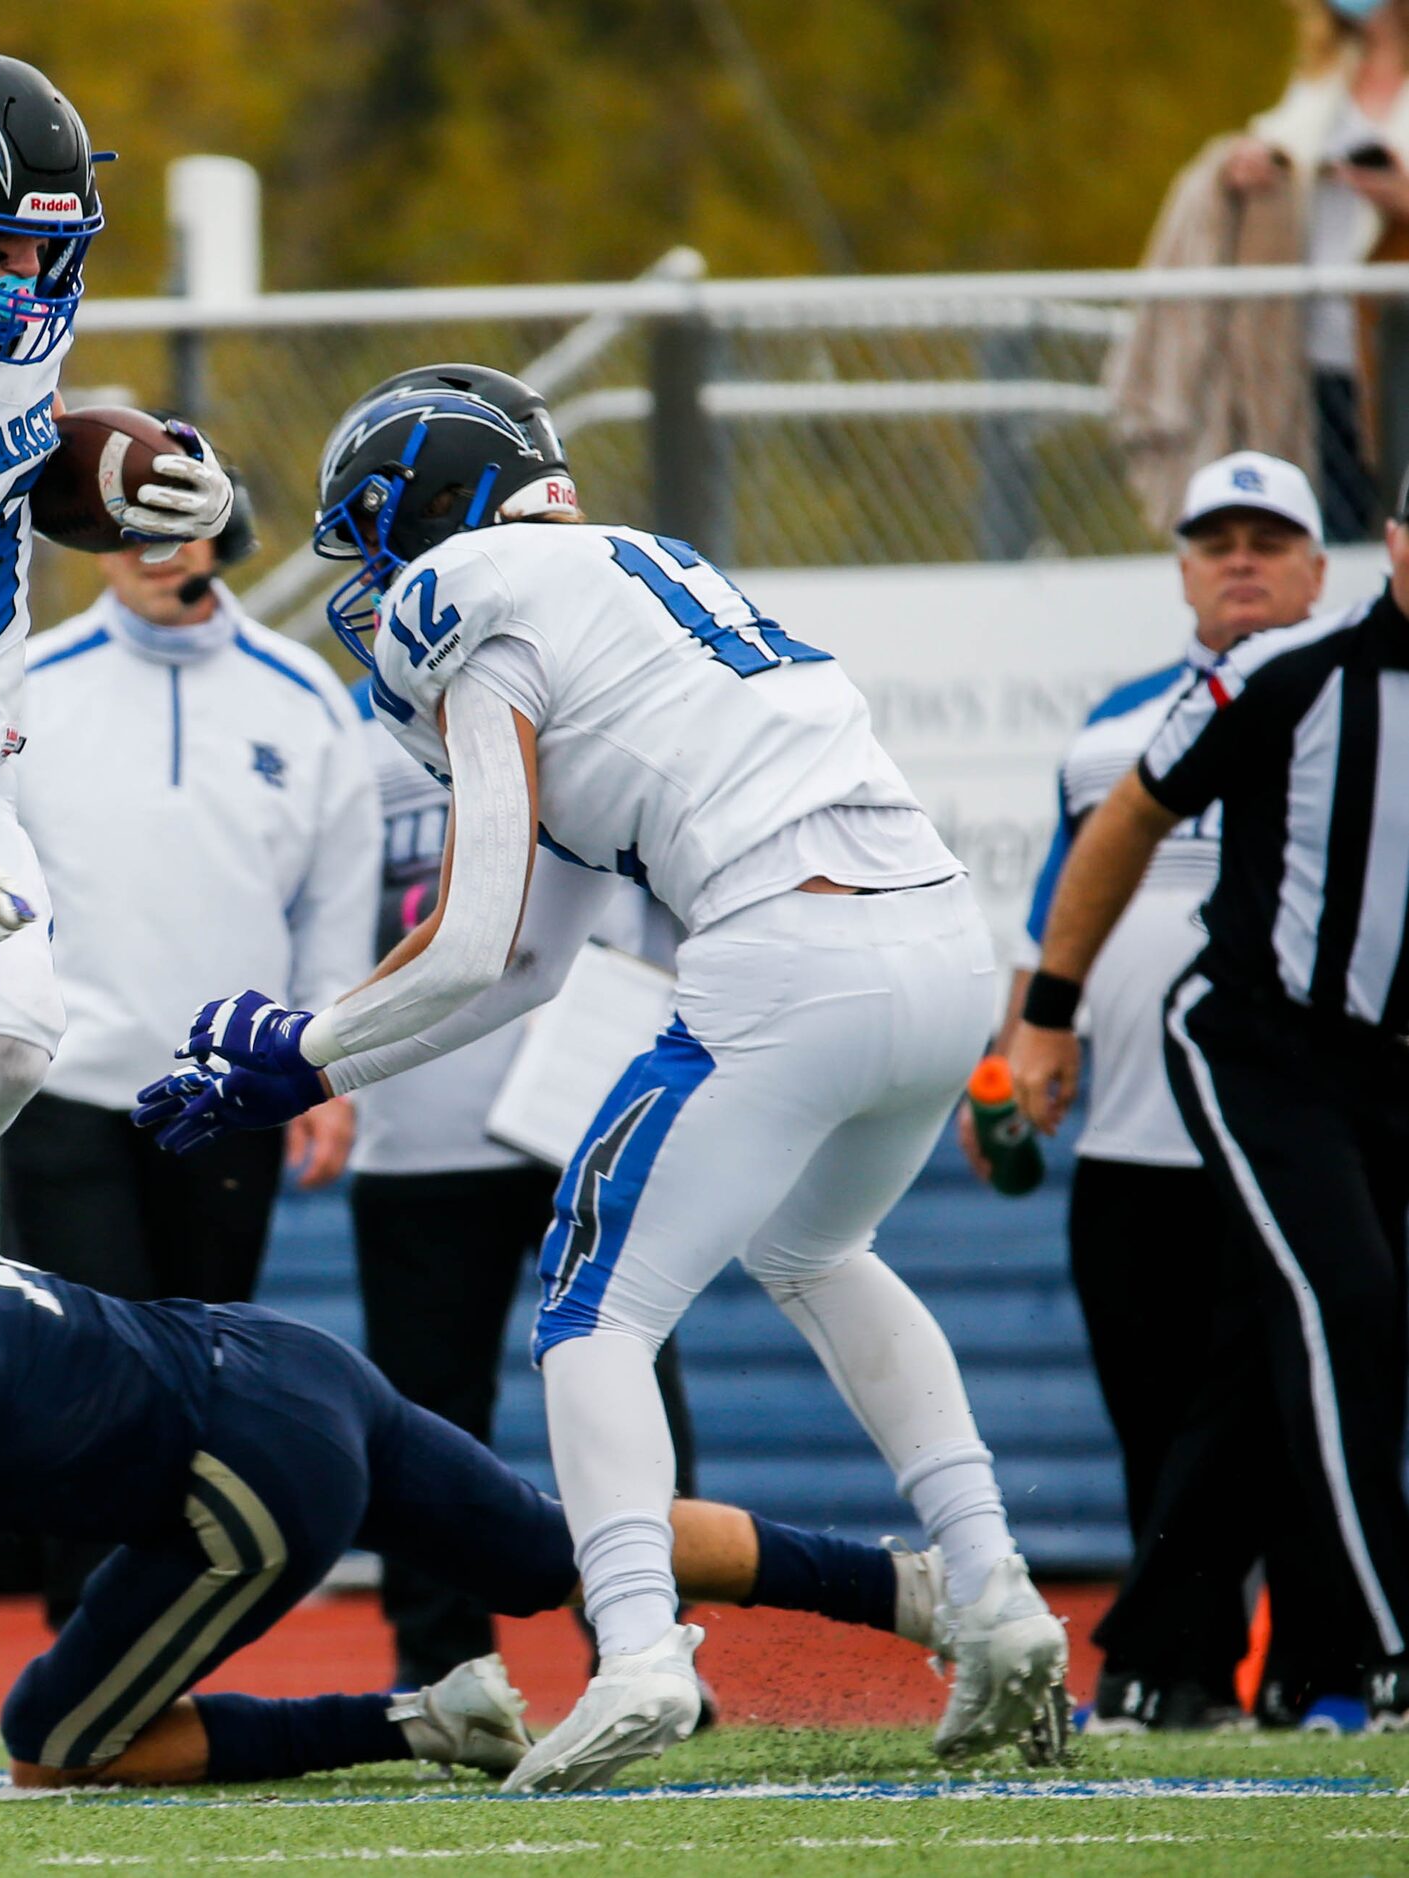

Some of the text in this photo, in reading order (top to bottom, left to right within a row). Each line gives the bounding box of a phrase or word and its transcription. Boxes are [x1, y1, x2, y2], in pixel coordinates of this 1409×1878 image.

[31, 198, 77, 212] Riddell
[389, 568, 462, 669] 12
[426, 632, 461, 671] Riddell
